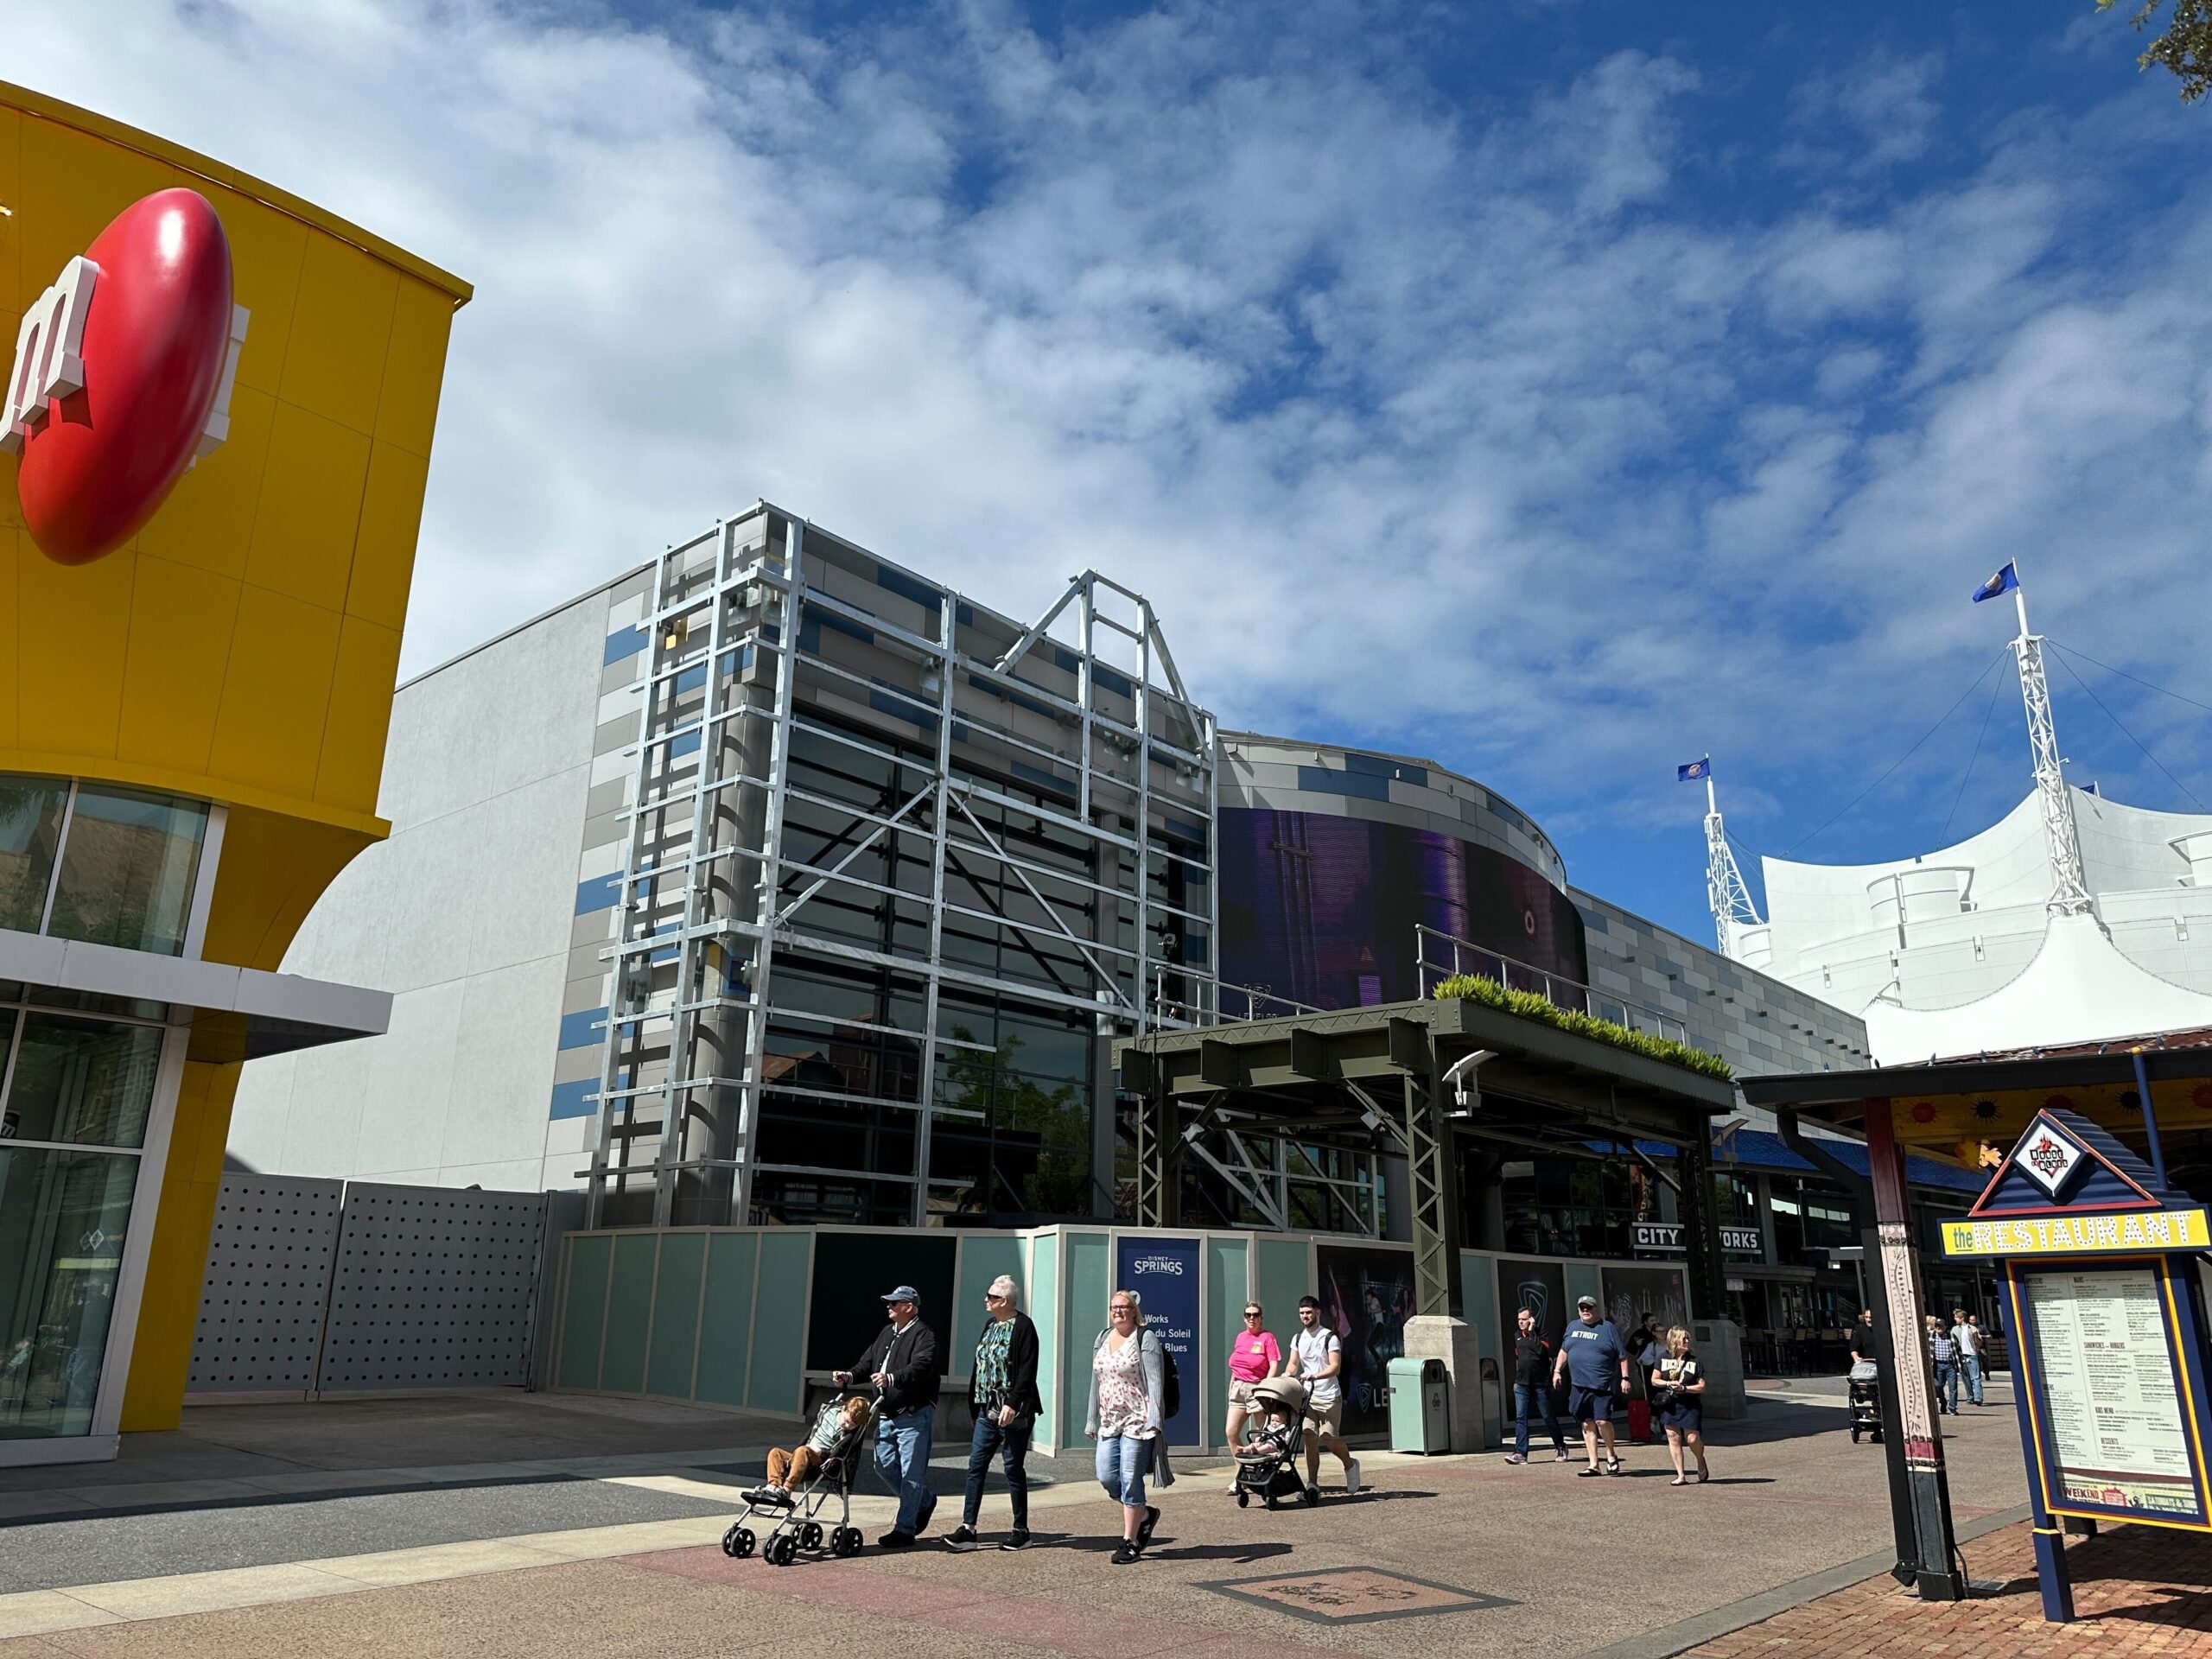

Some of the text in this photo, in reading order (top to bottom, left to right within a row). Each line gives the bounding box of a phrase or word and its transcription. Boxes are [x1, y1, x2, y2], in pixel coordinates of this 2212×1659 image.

[1954, 1212, 2192, 1251] the RESTAURANT
[1637, 1228, 1758, 1249] CITY ORKS
[1134, 1261, 1183, 1275] SPRINGS
[1145, 1314, 1169, 1324] Works
[1155, 1329, 1191, 1338] du Soleil
[1571, 1330, 1599, 1340] DETROIT
[1165, 1343, 1187, 1352] Blues
[2063, 1487, 2100, 1500] WEEKEND
